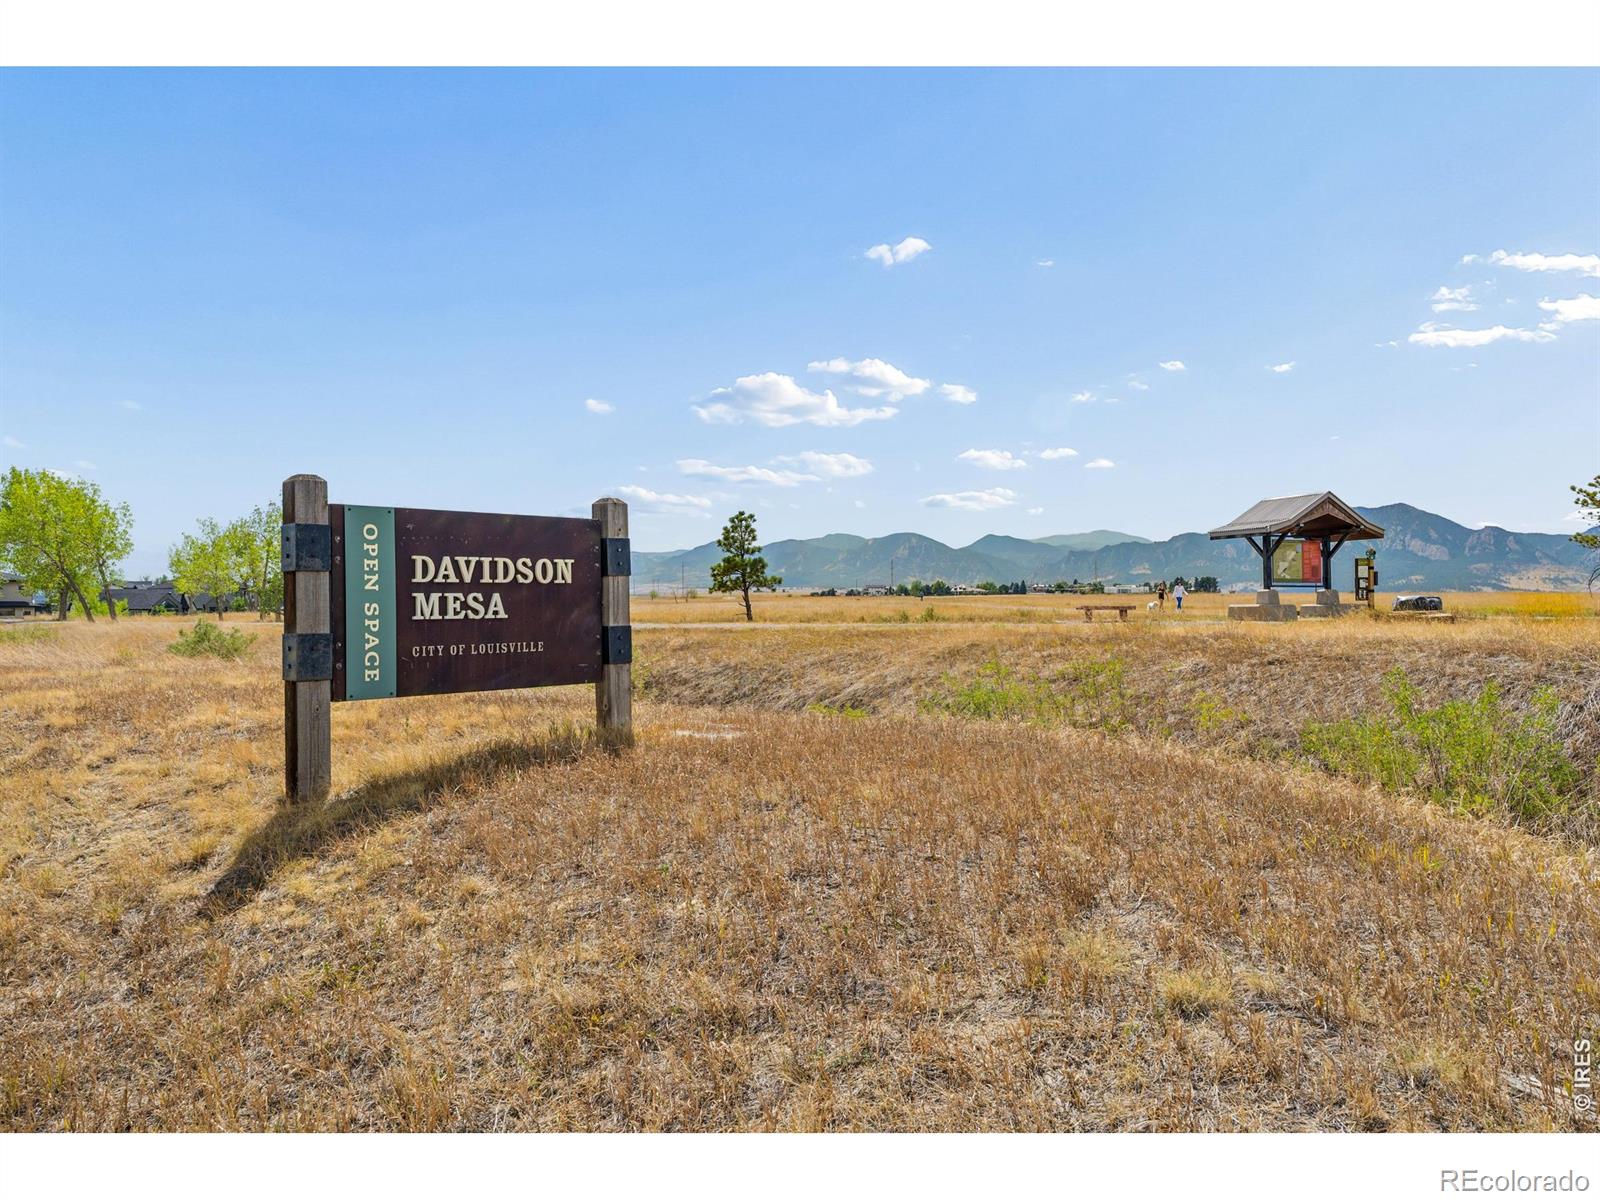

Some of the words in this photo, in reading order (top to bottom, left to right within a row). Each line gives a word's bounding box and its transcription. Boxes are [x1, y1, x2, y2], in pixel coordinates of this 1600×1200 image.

[362, 522, 380, 591] OPEN
[411, 555, 575, 584] DAVIDSON
[411, 592, 509, 621] MESA
[363, 602, 381, 682] SPACE
[412, 645, 445, 657] CITY
[450, 644, 466, 656] OF
[471, 641, 545, 655] LOUISVILLE
